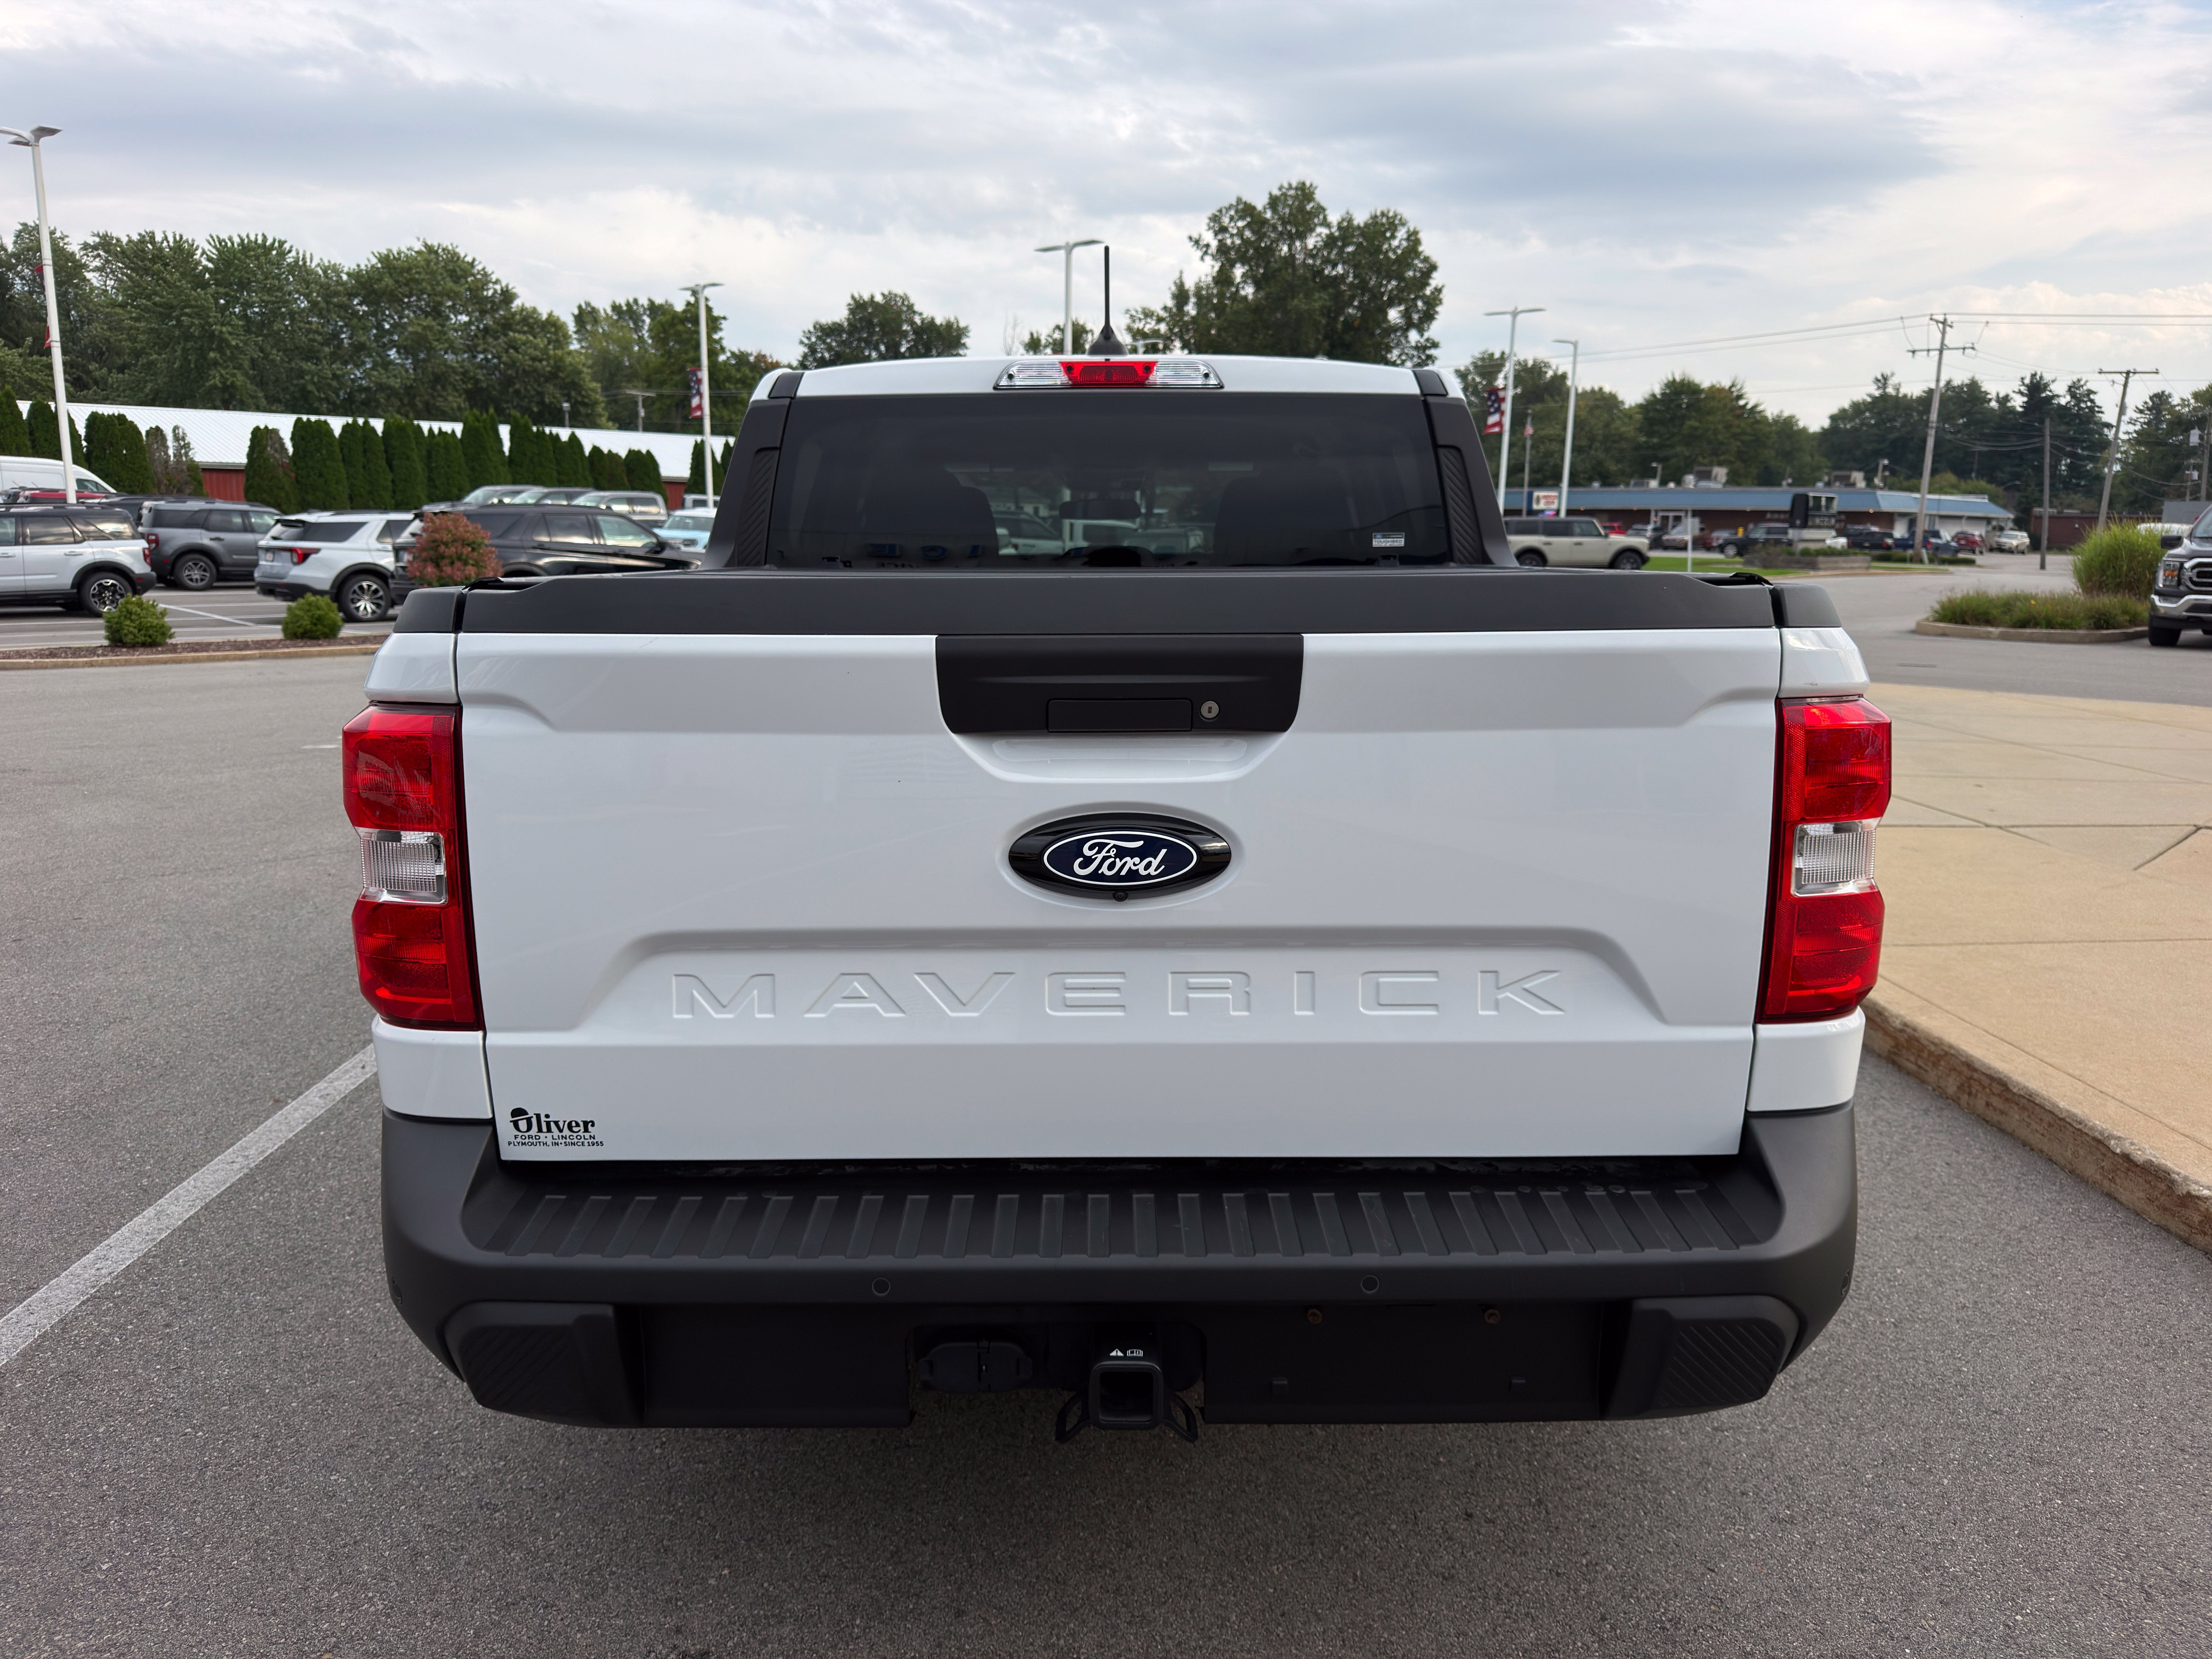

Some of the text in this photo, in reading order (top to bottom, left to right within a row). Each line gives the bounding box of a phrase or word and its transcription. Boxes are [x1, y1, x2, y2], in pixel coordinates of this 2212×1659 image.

[1073, 838, 1167, 876] Ford
[673, 970, 1565, 1018] MAVERICK
[510, 1107, 595, 1133] Oliver
